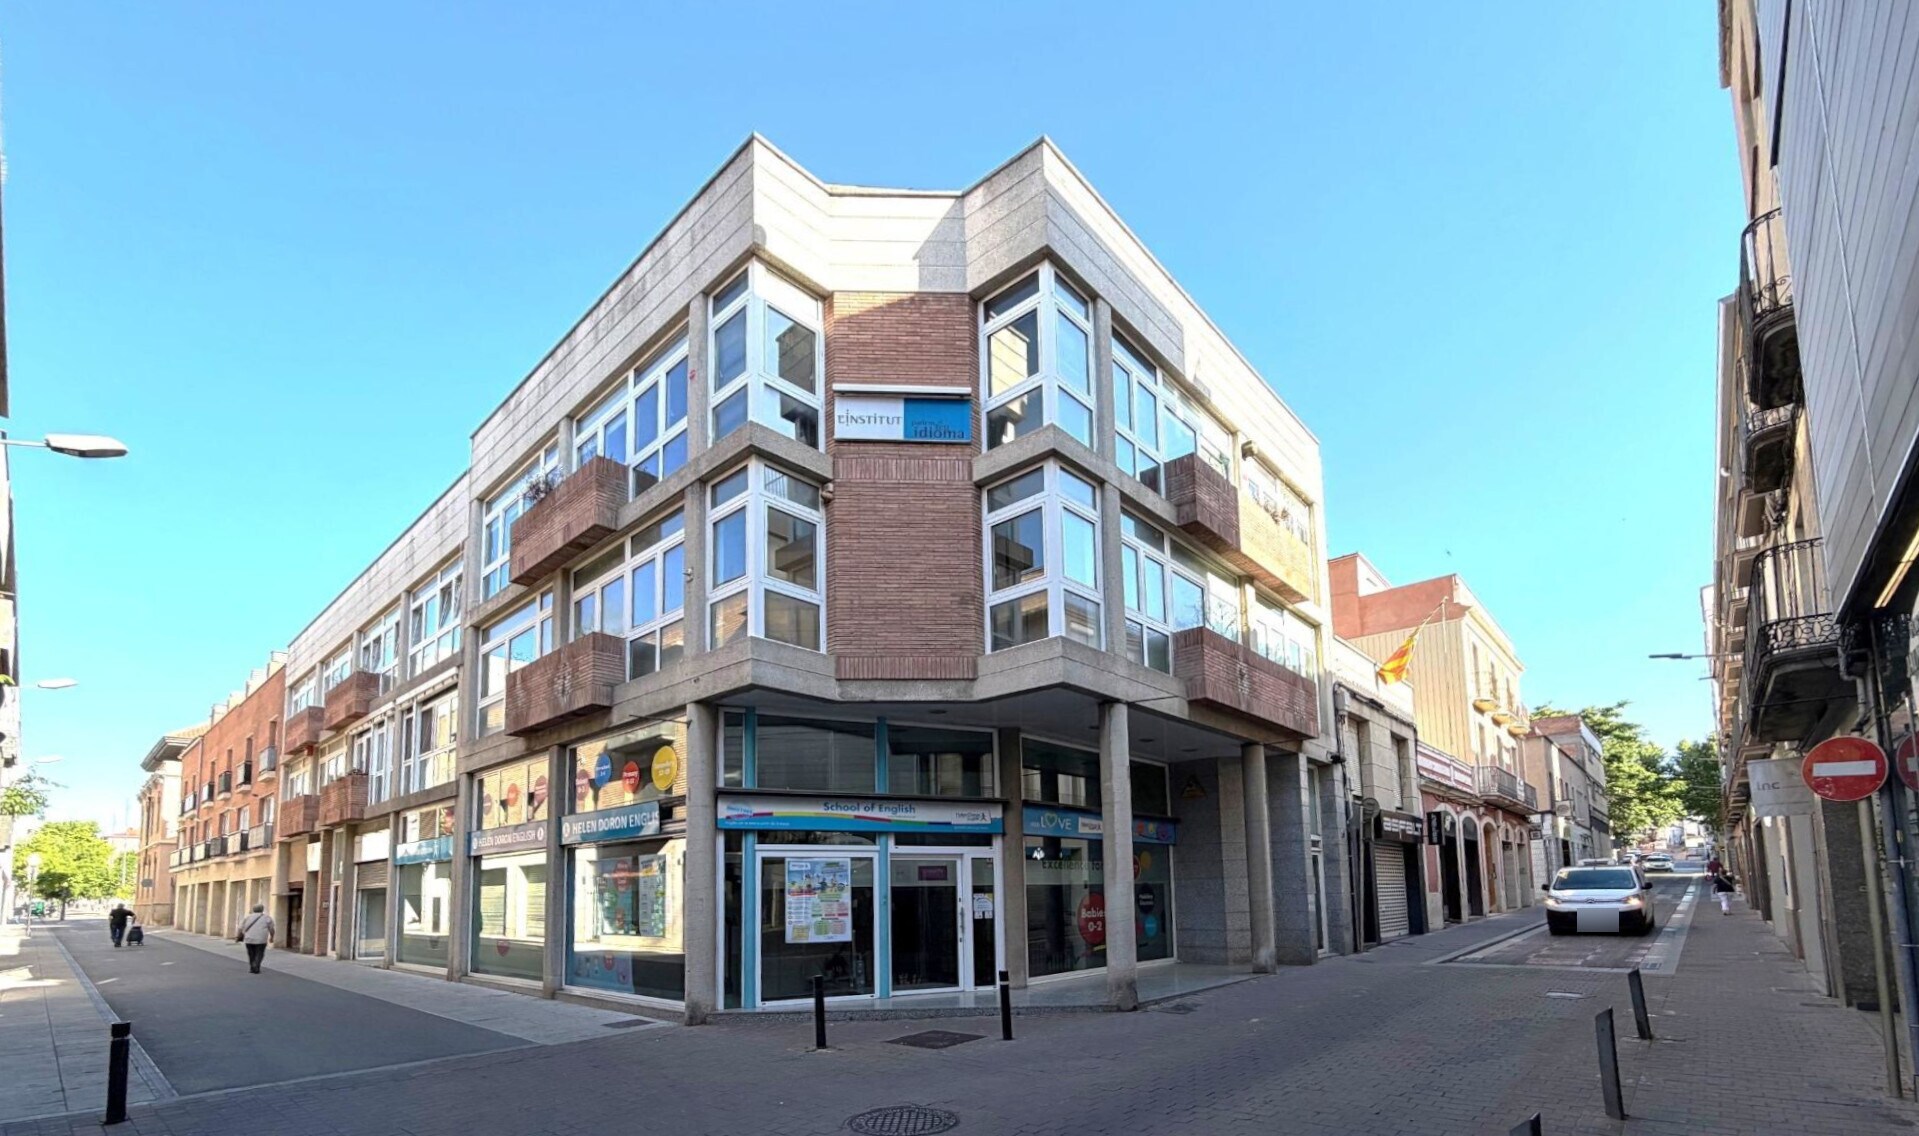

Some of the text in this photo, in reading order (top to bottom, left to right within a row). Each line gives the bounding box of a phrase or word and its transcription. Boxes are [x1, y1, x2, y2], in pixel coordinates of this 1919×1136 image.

[823, 802, 916, 815] School of English
[572, 820, 597, 835] HELEN
[598, 813, 628, 832] DORON
[512, 830, 536, 843] ENGLISH
[1088, 922, 1103, 932] 0-2
